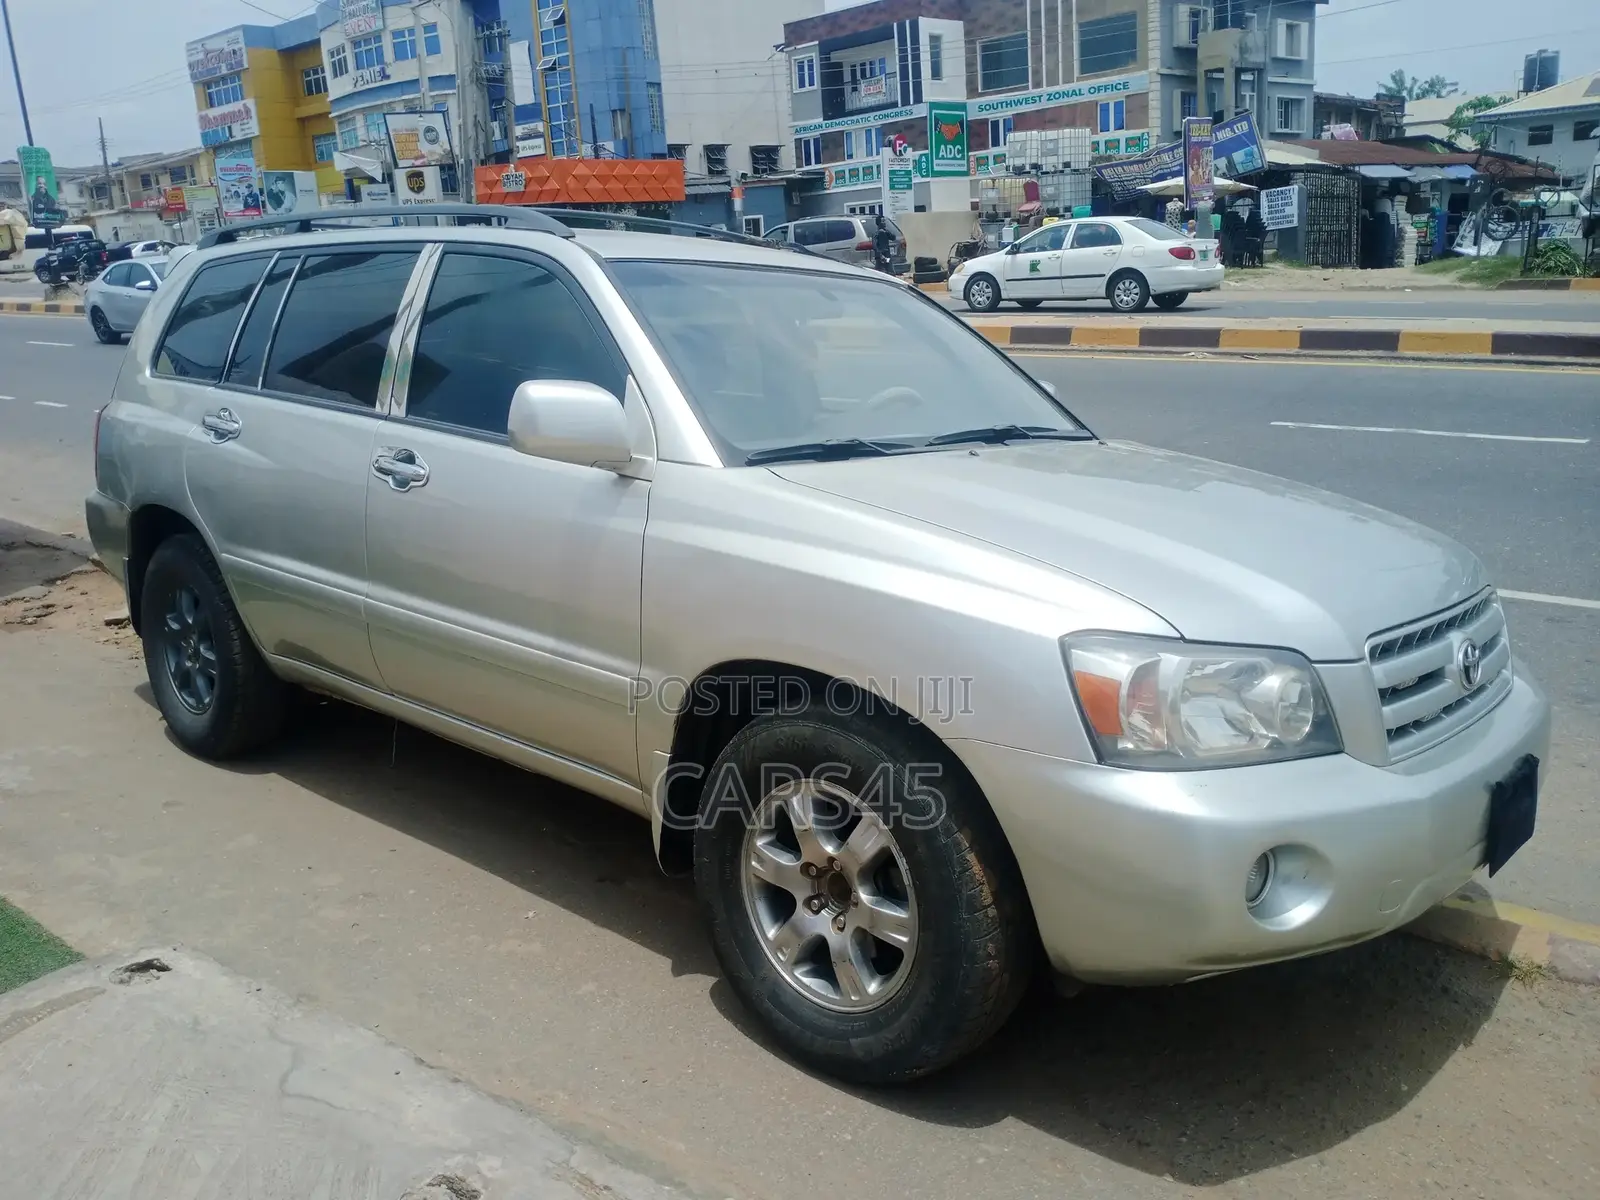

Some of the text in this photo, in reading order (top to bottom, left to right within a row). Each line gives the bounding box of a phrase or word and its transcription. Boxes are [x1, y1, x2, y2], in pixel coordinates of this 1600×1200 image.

[344, 15, 377, 37] EVENT
[977, 81, 1130, 113] SOUTHWEST ZONAL OFFICE
[794, 109, 914, 134] AFRICAN DEMOCRATIC CONGRESS
[1235, 121, 1250, 133] LTD
[939, 145, 962, 158] ADC
